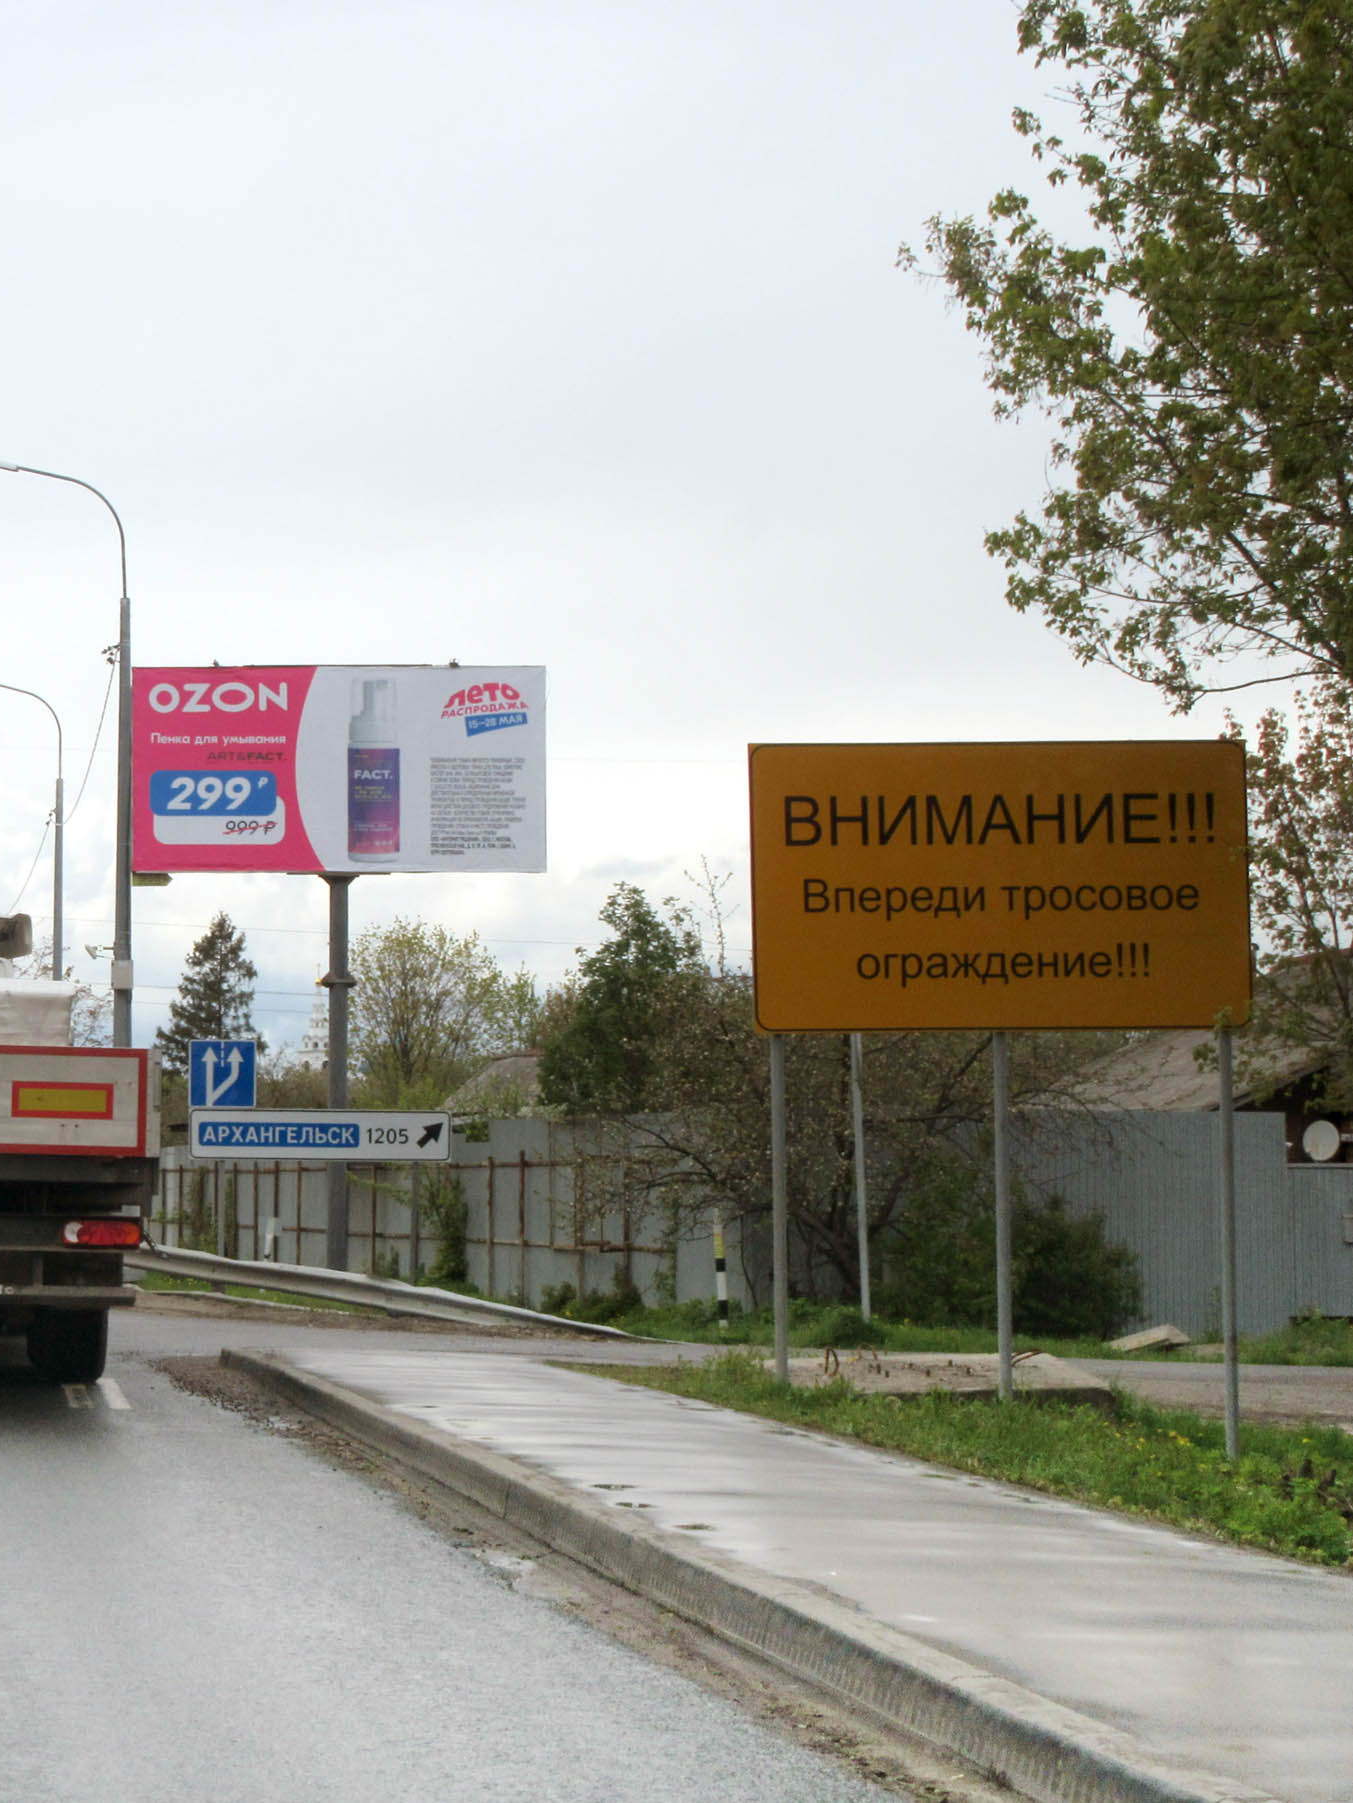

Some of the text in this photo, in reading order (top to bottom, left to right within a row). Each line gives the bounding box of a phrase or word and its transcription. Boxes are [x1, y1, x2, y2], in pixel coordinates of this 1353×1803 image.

[149, 682, 288, 714] OZON
[498, 715, 523, 727] МАЯ
[151, 732, 287, 747] Пенка для умывания
[783, 792, 1216, 847] ВНИМАНИЕ!!!
[803, 878, 1200, 921] Впереди тросовое
[856, 942, 1150, 988] ограждение!!!
[202, 1125, 409, 1146] АРХАНГЕЛЬСК 1205
